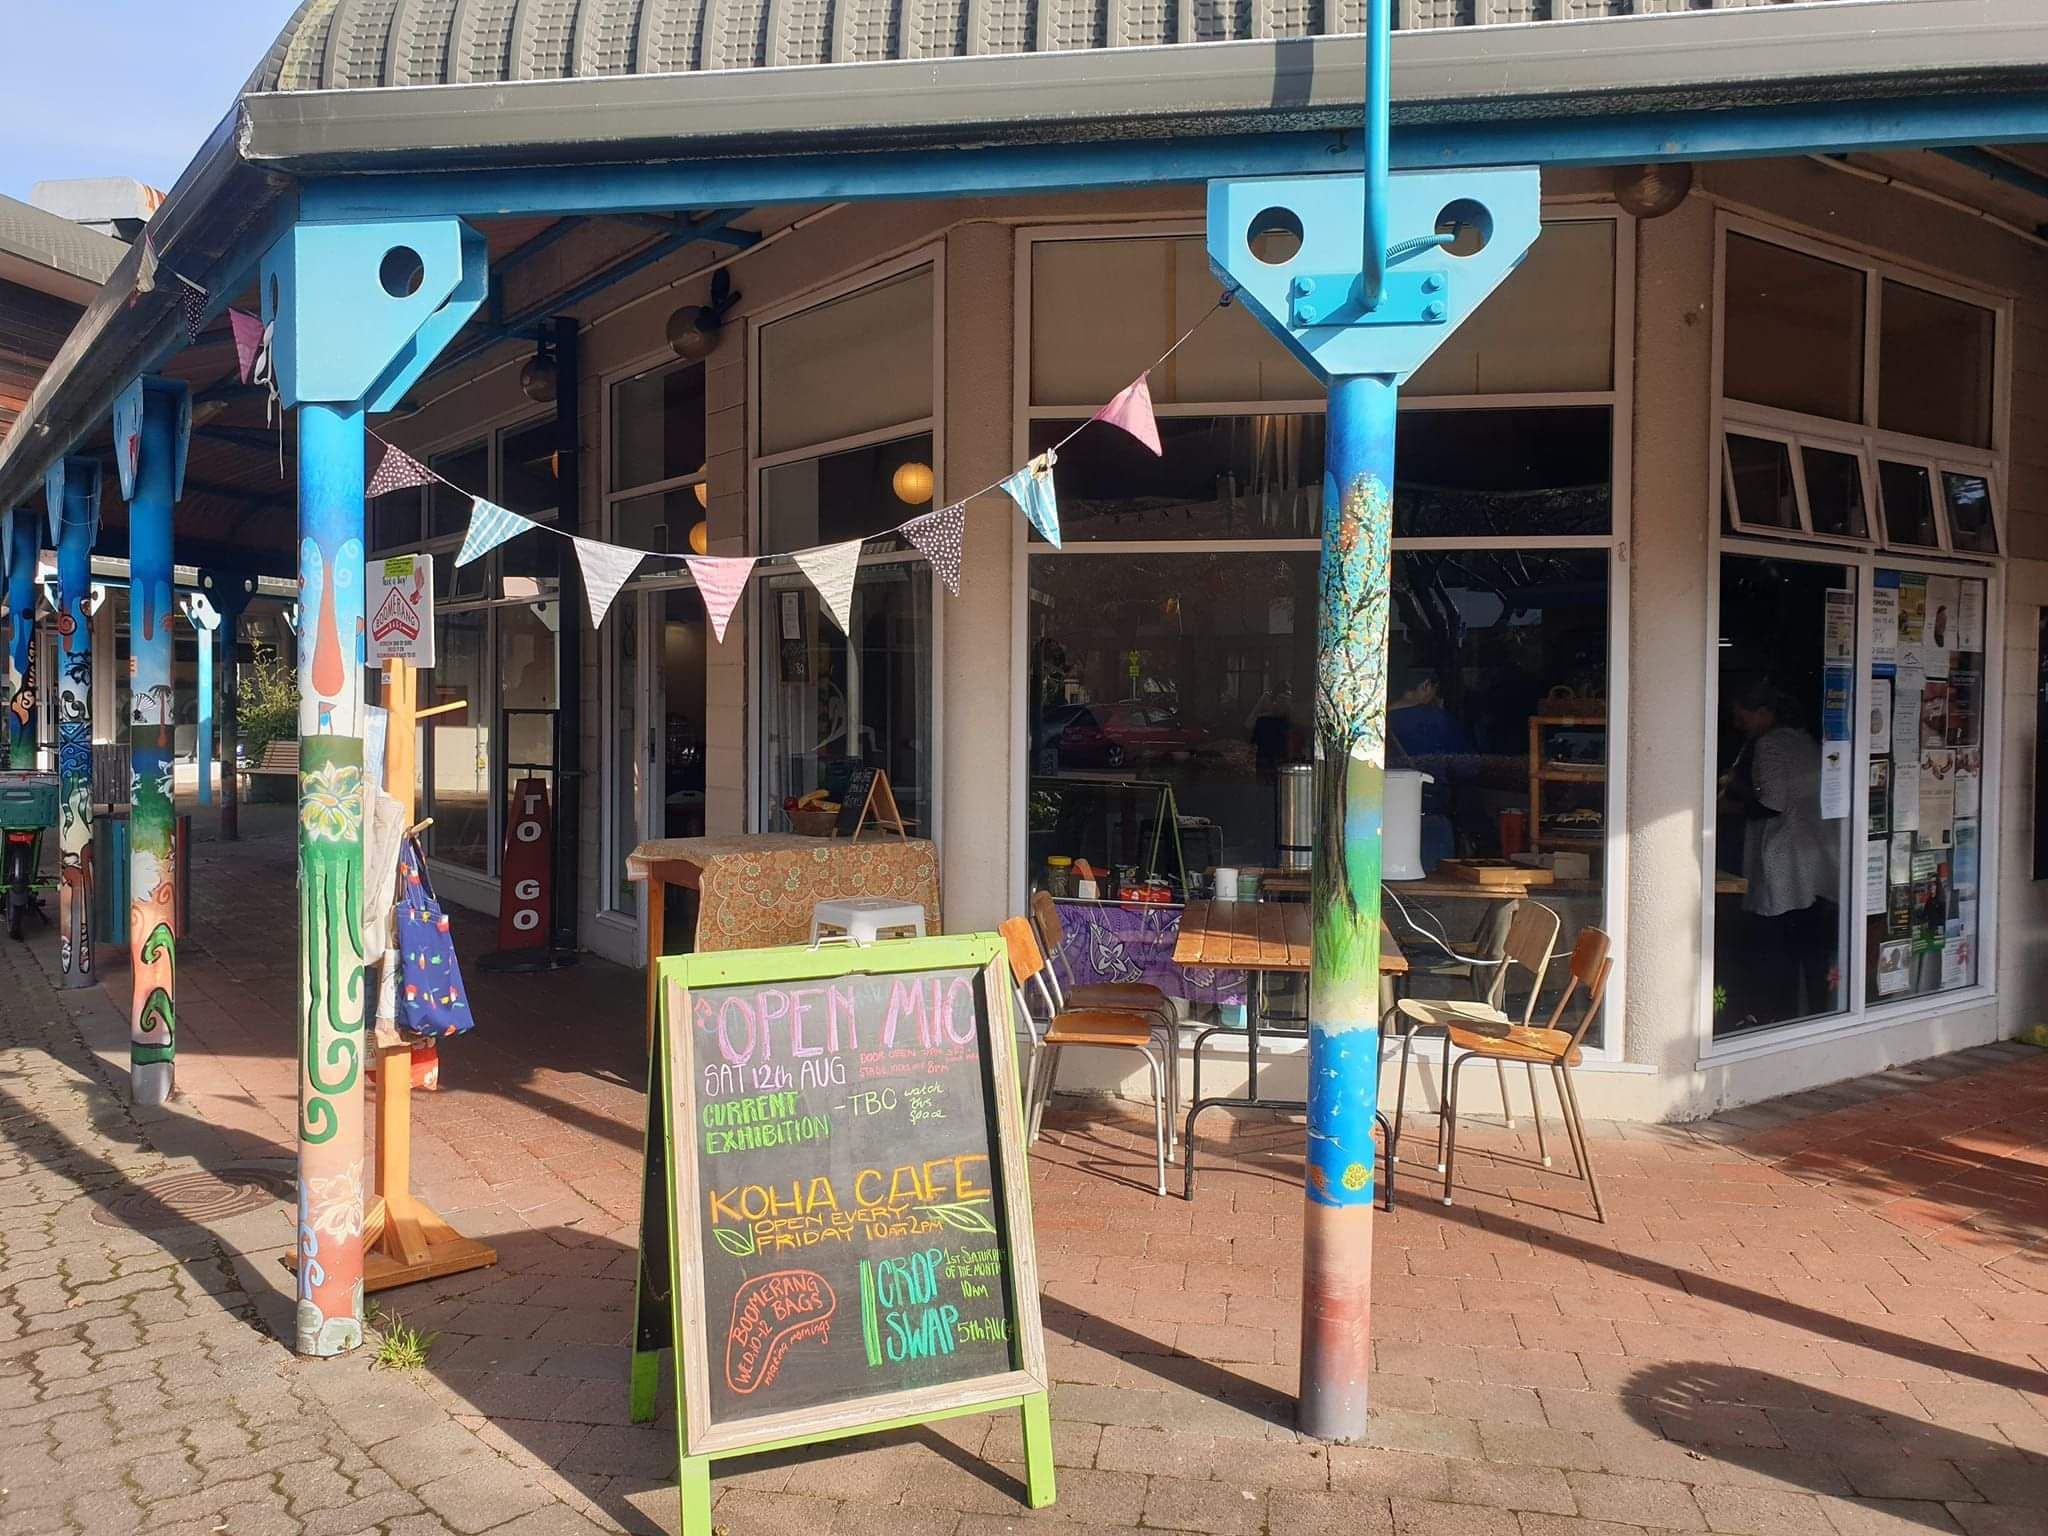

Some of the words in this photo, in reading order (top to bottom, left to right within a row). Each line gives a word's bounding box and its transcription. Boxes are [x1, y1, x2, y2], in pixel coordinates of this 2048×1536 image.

[376, 594, 416, 628] BOOMERANG
[516, 794, 542, 842] TO
[513, 879, 540, 930] GO
[718, 985, 857, 1063] OPEN
[704, 1063, 746, 1097] SAT
[751, 1064, 793, 1091] 12th
[801, 1056, 847, 1090] AUG
[703, 1091, 800, 1127] CURRENT
[705, 1114, 832, 1155] EXHIBITION
[709, 1176, 837, 1225] KOHA
[855, 1154, 991, 1208] CAFE
[754, 1212, 823, 1234] OPEN
[831, 1203, 910, 1225] EVERY
[756, 1226, 855, 1256] FRIDAY
[877, 1247, 944, 1308] CROP
[945, 1265, 956, 1279] OF
[957, 1264, 973, 1278] THE
[973, 1262, 1001, 1277] MONTH
[731, 1274, 820, 1348] BOOMERANG
[771, 1292, 823, 1321] BAGS
[886, 1304, 960, 1362] SWAP
